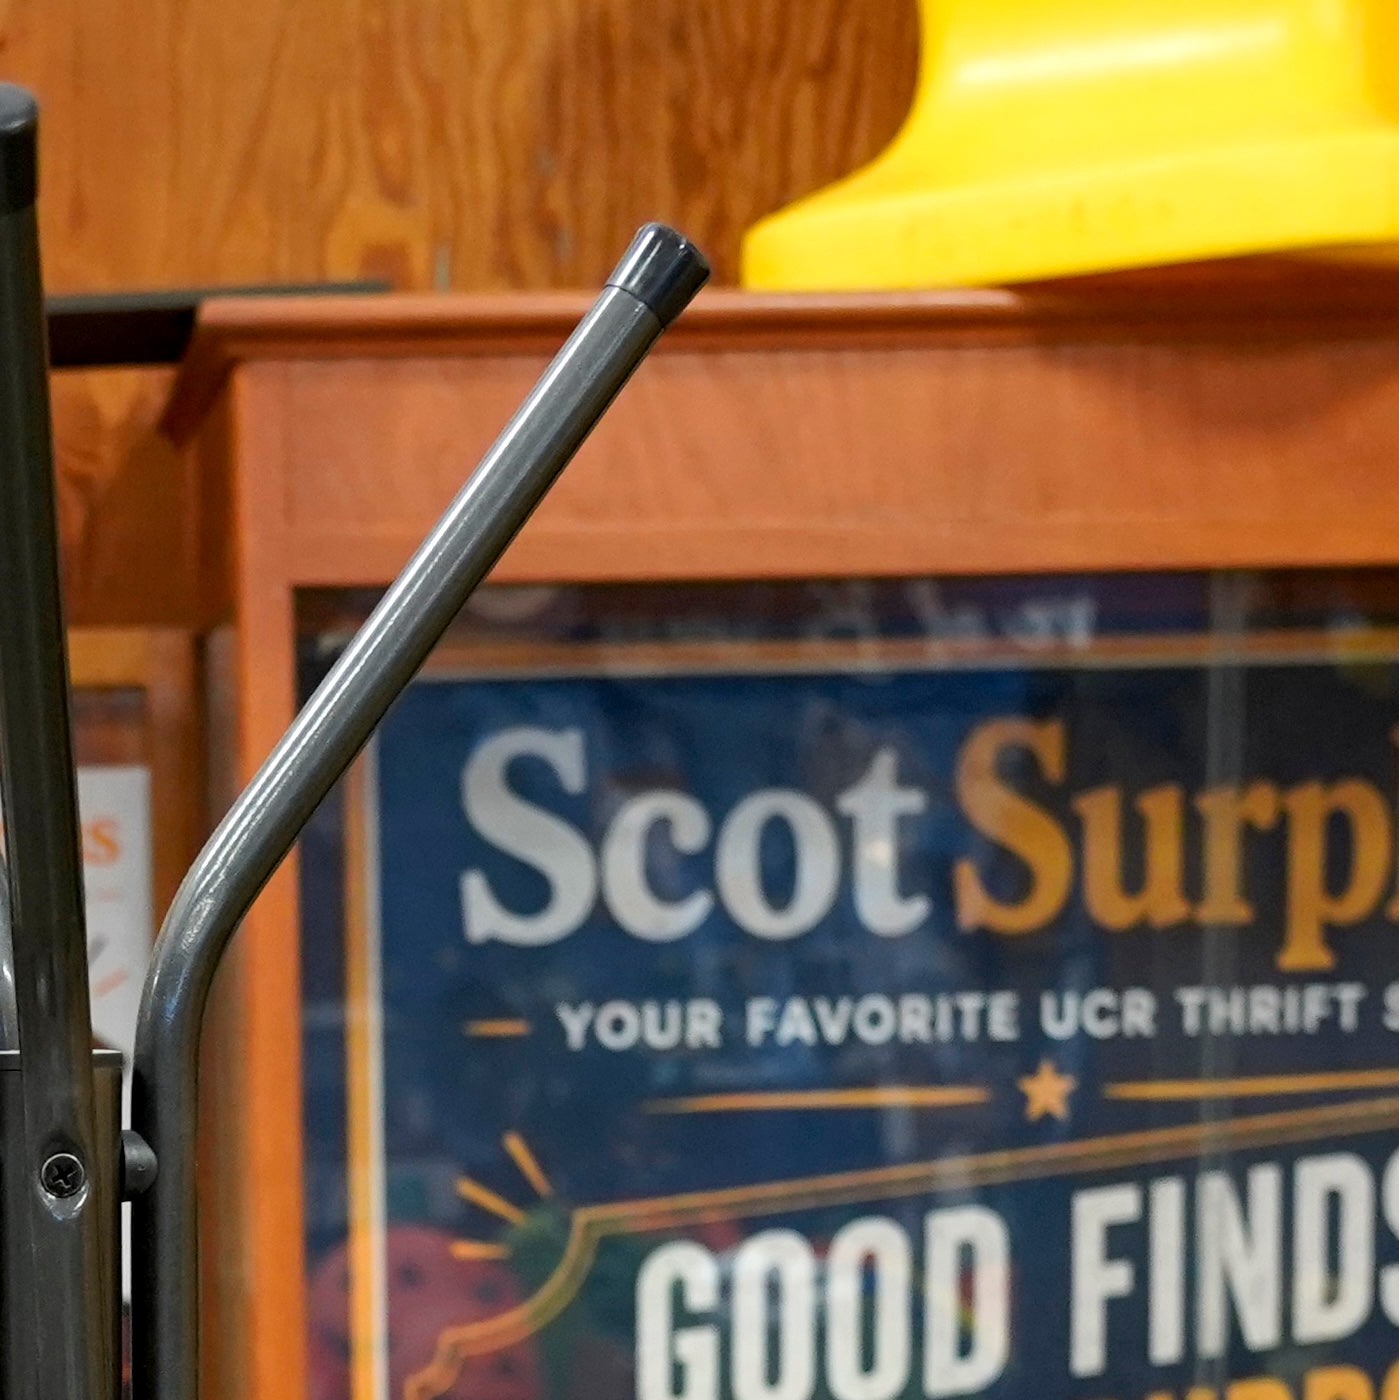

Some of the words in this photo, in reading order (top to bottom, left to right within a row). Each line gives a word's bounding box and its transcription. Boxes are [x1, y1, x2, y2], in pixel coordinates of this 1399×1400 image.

[460, 726, 932, 946] Scot
[955, 716, 1399, 970] Surp
[556, 1000, 723, 1051] YOUR
[746, 992, 1020, 1046] FAVORITE
[1040, 988, 1157, 1042] UCR
[1180, 982, 1367, 1037] THRIFT
[1070, 1145, 1399, 1378] FIND
